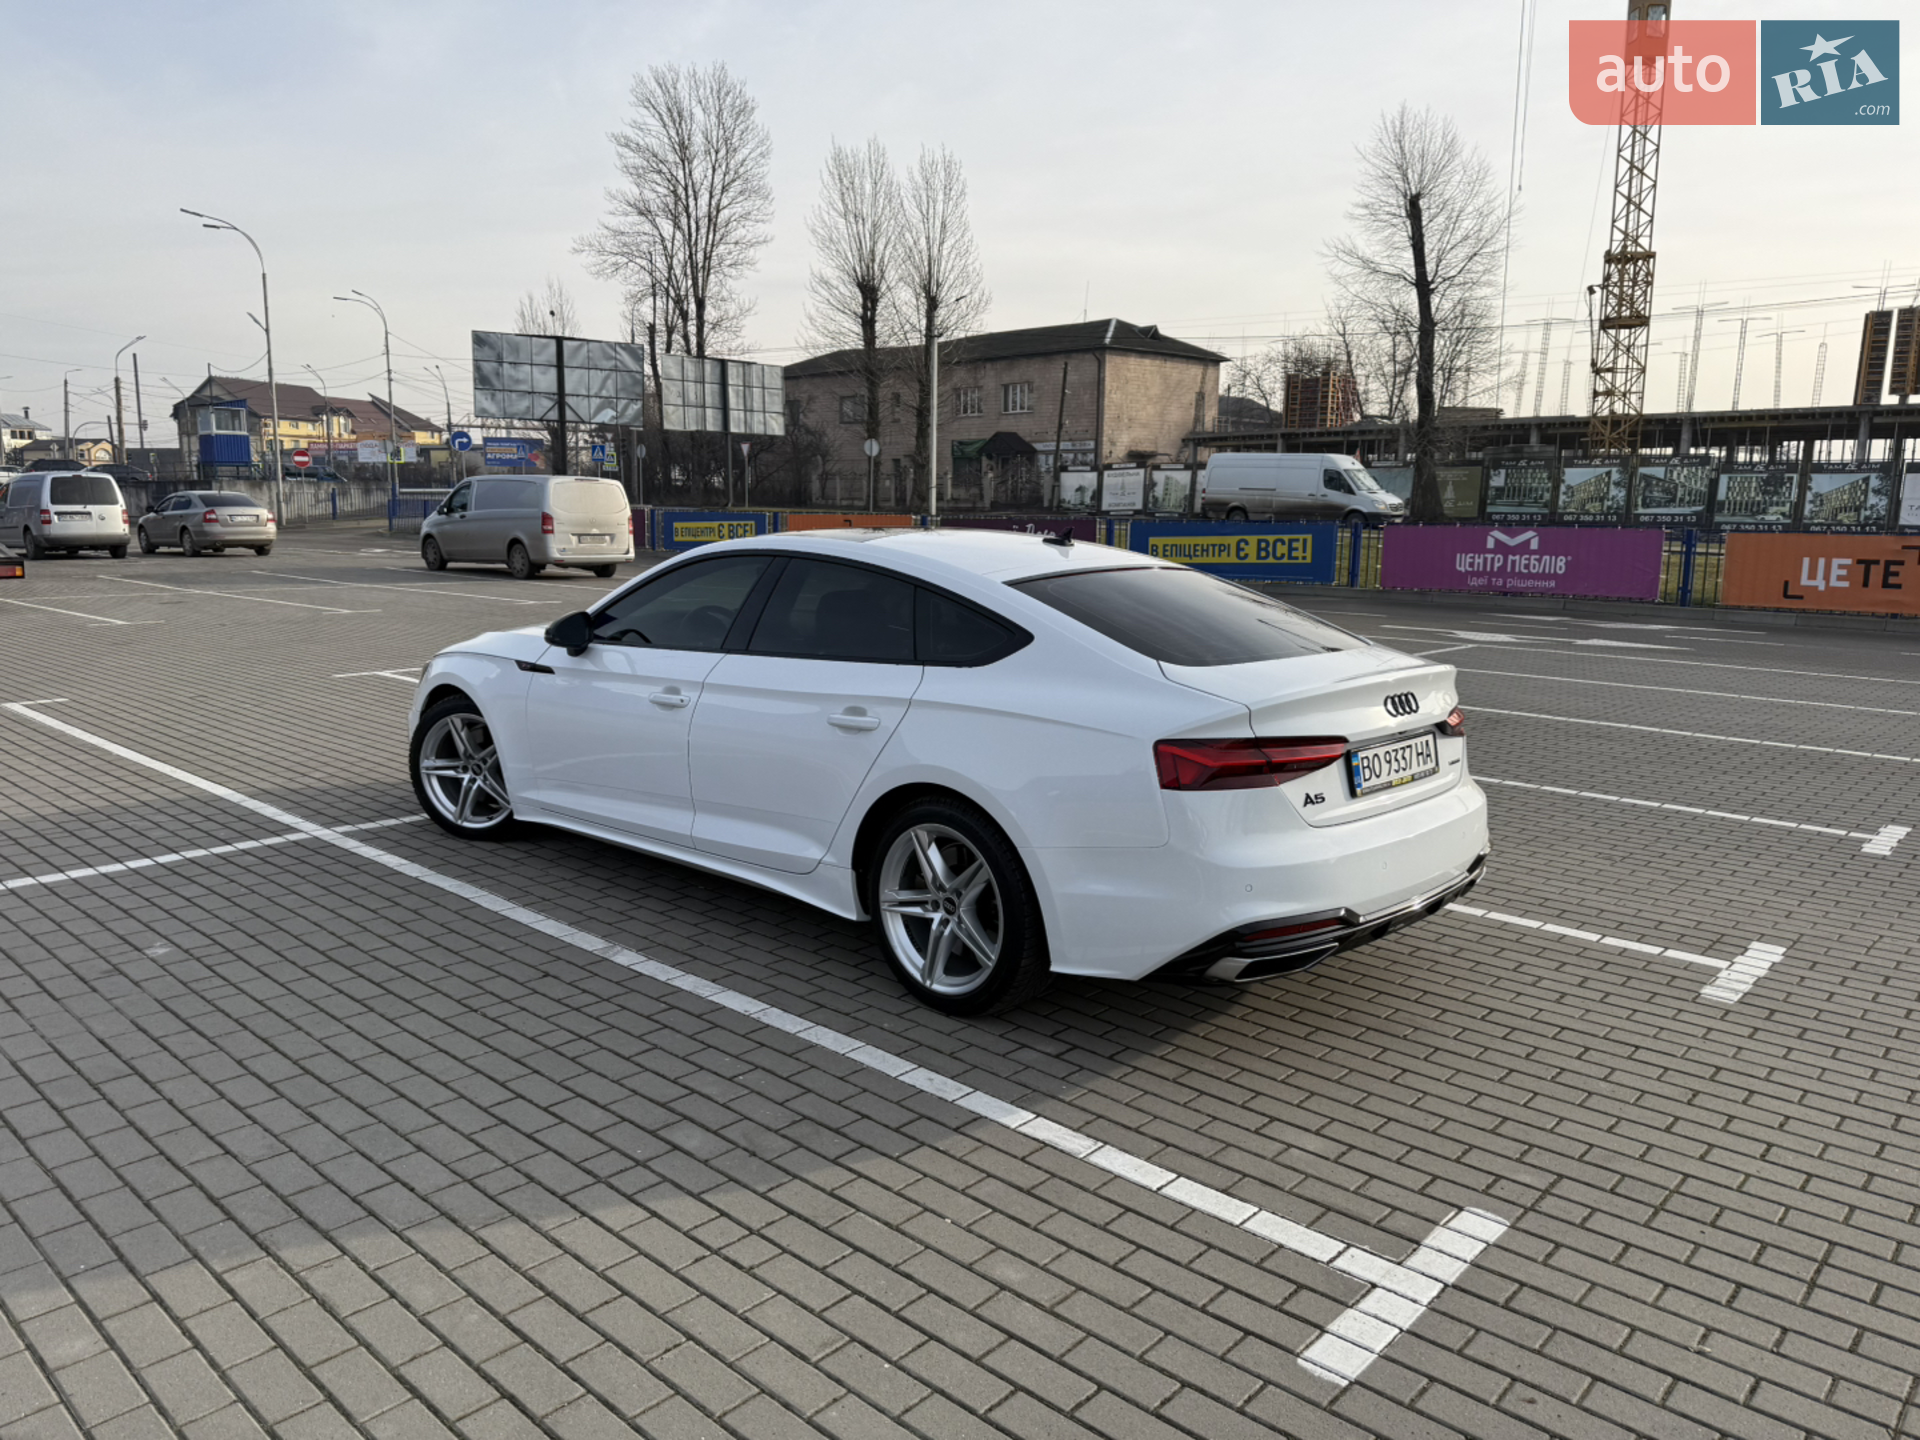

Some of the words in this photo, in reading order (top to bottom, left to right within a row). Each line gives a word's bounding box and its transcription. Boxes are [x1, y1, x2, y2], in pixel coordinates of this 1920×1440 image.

[1151, 544, 1159, 557] В
[1162, 543, 1231, 560] ЕПІЦЕНТРІ
[1235, 538, 1249, 561] Є
[1256, 538, 1308, 561] ВСЕ!
[1456, 553, 1504, 573] ЦЕНТР
[1491, 577, 1503, 586] та
[1506, 577, 1556, 588] рішення
[1800, 557, 1905, 592] ЦЕТЕ
[1384, 744, 1413, 777] 9337
[1302, 792, 1326, 808] A5
